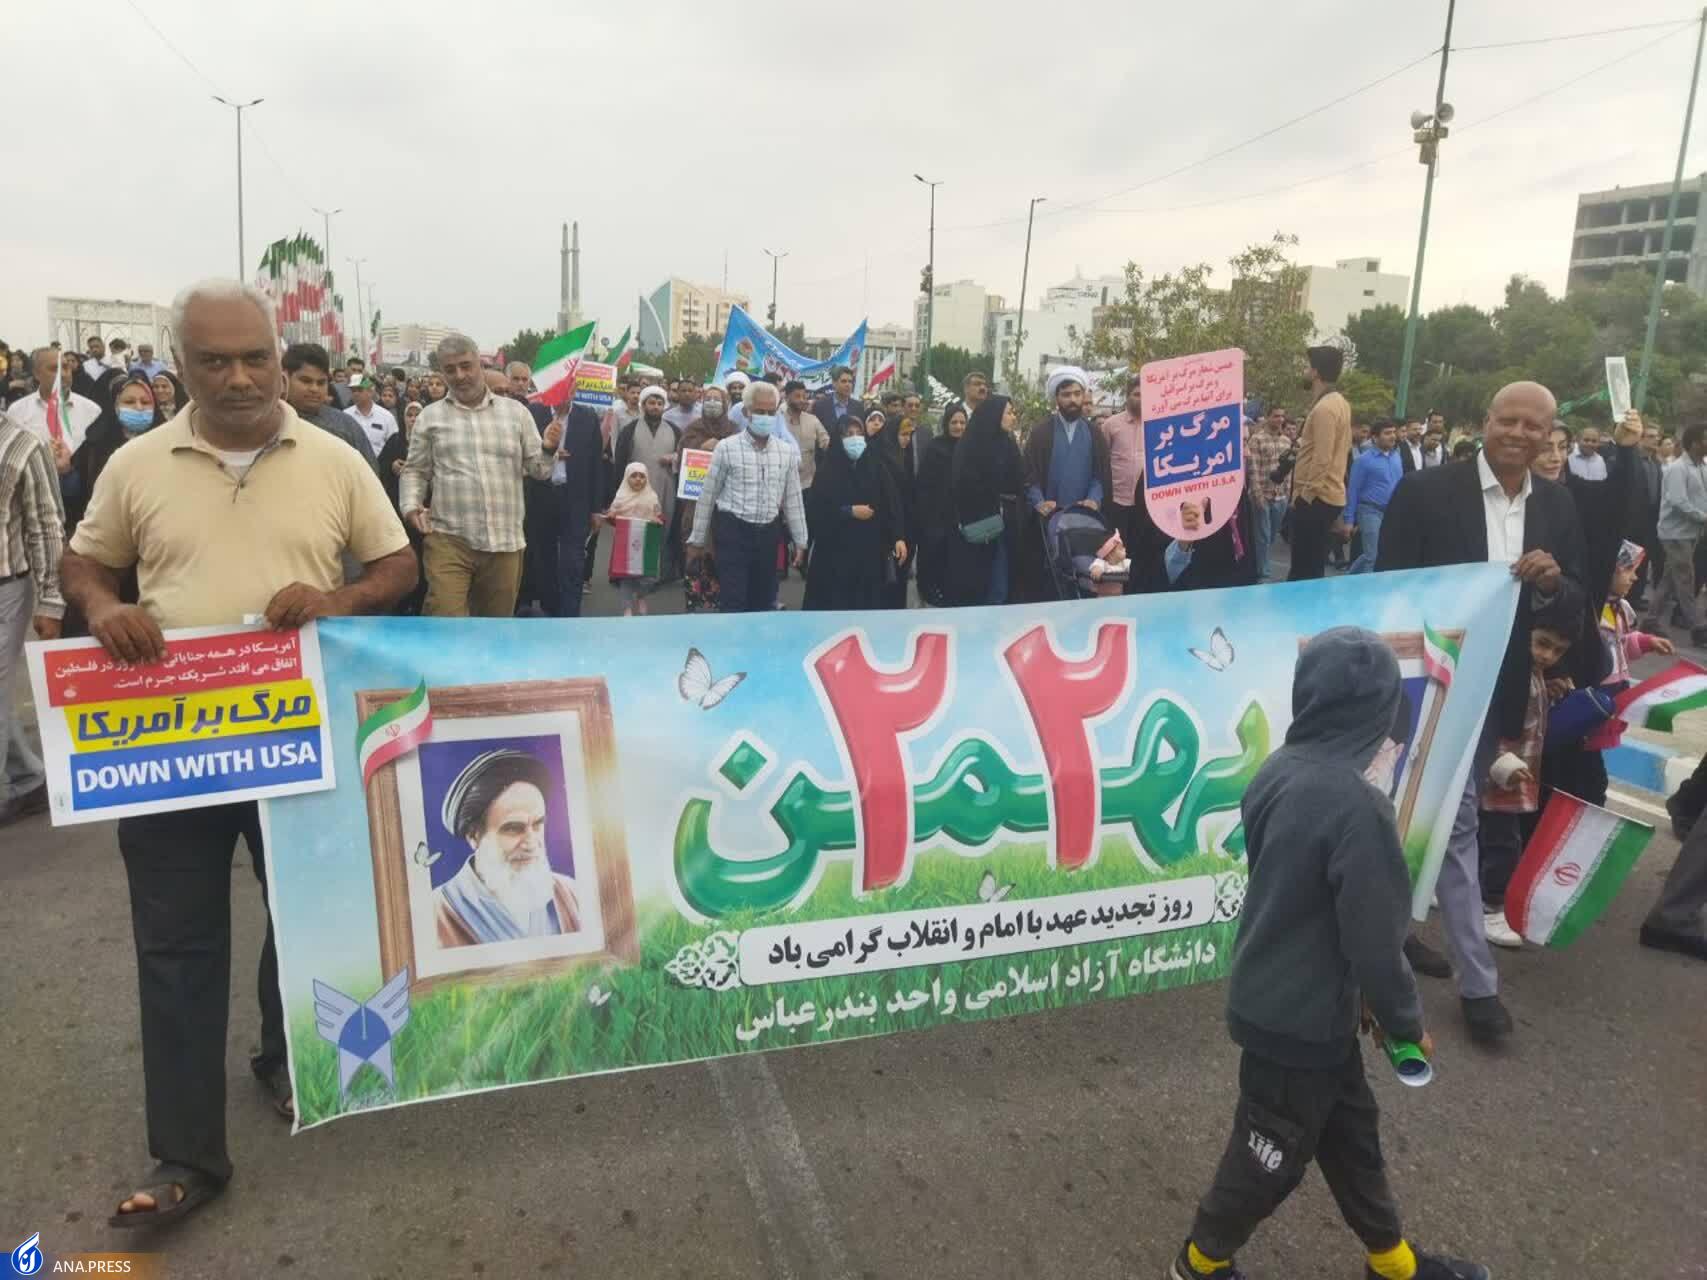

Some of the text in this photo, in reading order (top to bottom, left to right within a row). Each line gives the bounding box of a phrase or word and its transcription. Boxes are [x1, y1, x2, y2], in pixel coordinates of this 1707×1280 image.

[1153, 412, 1230, 450] مرگ بر
[1151, 488, 1181, 501] DOWN
[1183, 482, 1209, 495] WITH
[163, 650, 204, 670] جنایاتی
[207, 648, 235, 661] همه
[238, 644, 252, 659] در
[55, 661, 98, 679] فلسطین
[99, 660, 113, 674] در
[178, 666, 226, 683] شریک
[251, 664, 270, 676] می
[271, 657, 297, 673] اتفاق
[145, 674, 175, 690] جرم
[77, 689, 312, 746] مرگ بر آمریکا
[76, 742, 317, 793] DOWN WITH USA
[673, 698, 1270, 918] بهمن
[768, 894, 1193, 969] روز تجدید عهد با امام و انقلاب گرامی باد
[1128, 938, 1216, 977] دانشگاه
[1065, 948, 1123, 992] آزاد
[965, 959, 1058, 1010] اسلامی
[886, 976, 957, 1015] واحد
